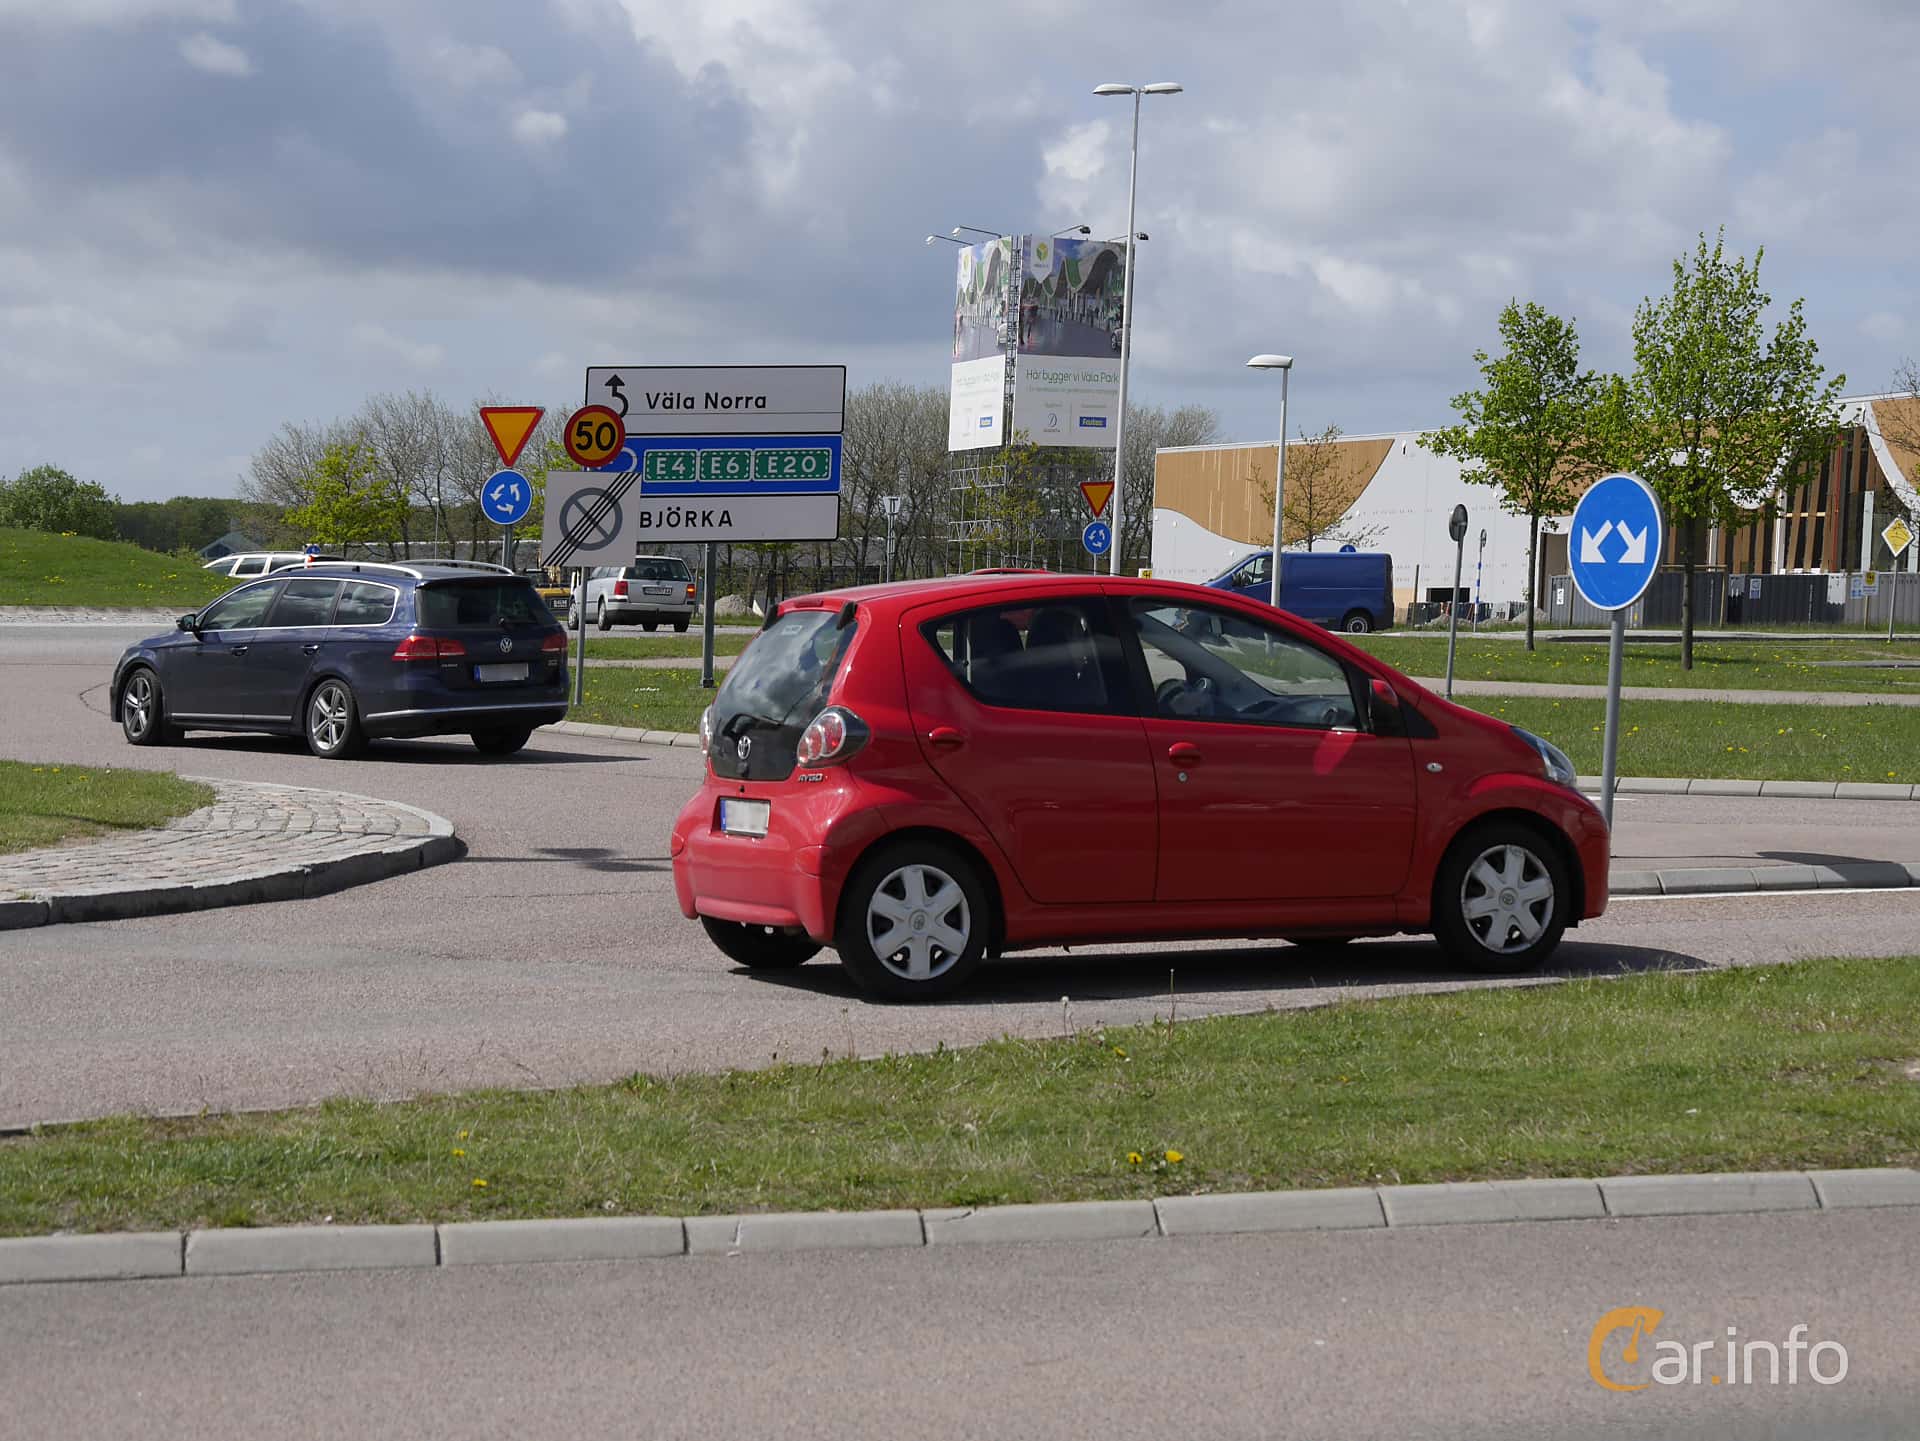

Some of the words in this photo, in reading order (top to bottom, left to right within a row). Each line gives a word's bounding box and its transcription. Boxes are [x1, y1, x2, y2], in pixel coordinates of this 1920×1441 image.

[646, 392, 695, 410] Väla
[704, 393, 767, 410] Norra
[575, 421, 616, 451] 50
[656, 459, 686, 475] E4
[710, 458, 740, 474] E6
[767, 455, 817, 474] E20
[640, 507, 733, 528] BJÖRKA
